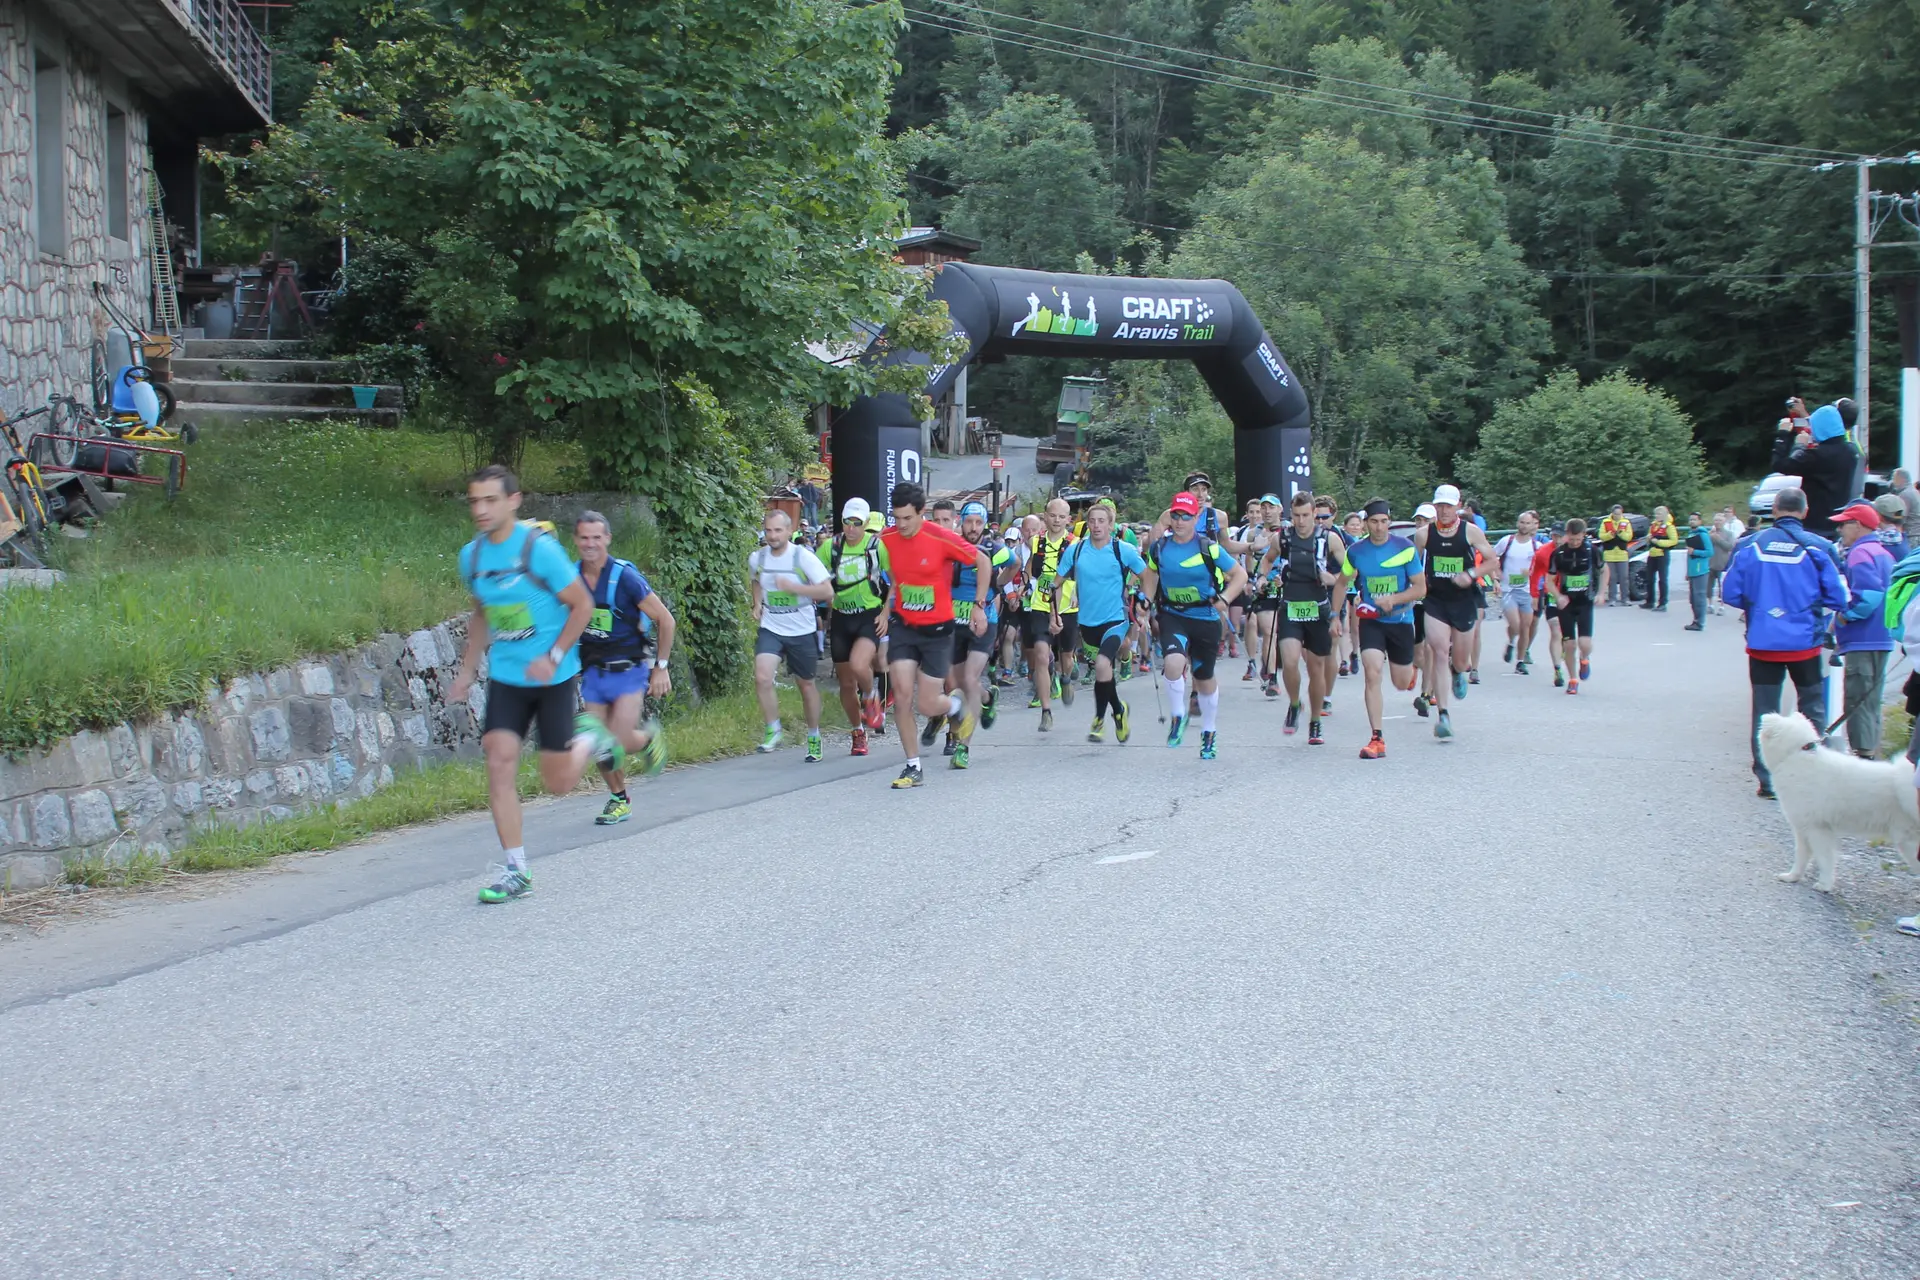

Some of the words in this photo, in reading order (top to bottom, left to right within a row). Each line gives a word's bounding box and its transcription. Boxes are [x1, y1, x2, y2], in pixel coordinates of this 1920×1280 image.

[1122, 296, 1194, 320] CRAFT
[1112, 322, 1179, 340] Aravis
[1183, 324, 1215, 340] Trail
[1259, 342, 1285, 377] CRAFT
[1440, 563, 1456, 572] 710
[1375, 583, 1389, 593] 727
[1175, 593, 1192, 603] 830
[1296, 608, 1311, 617] 792
